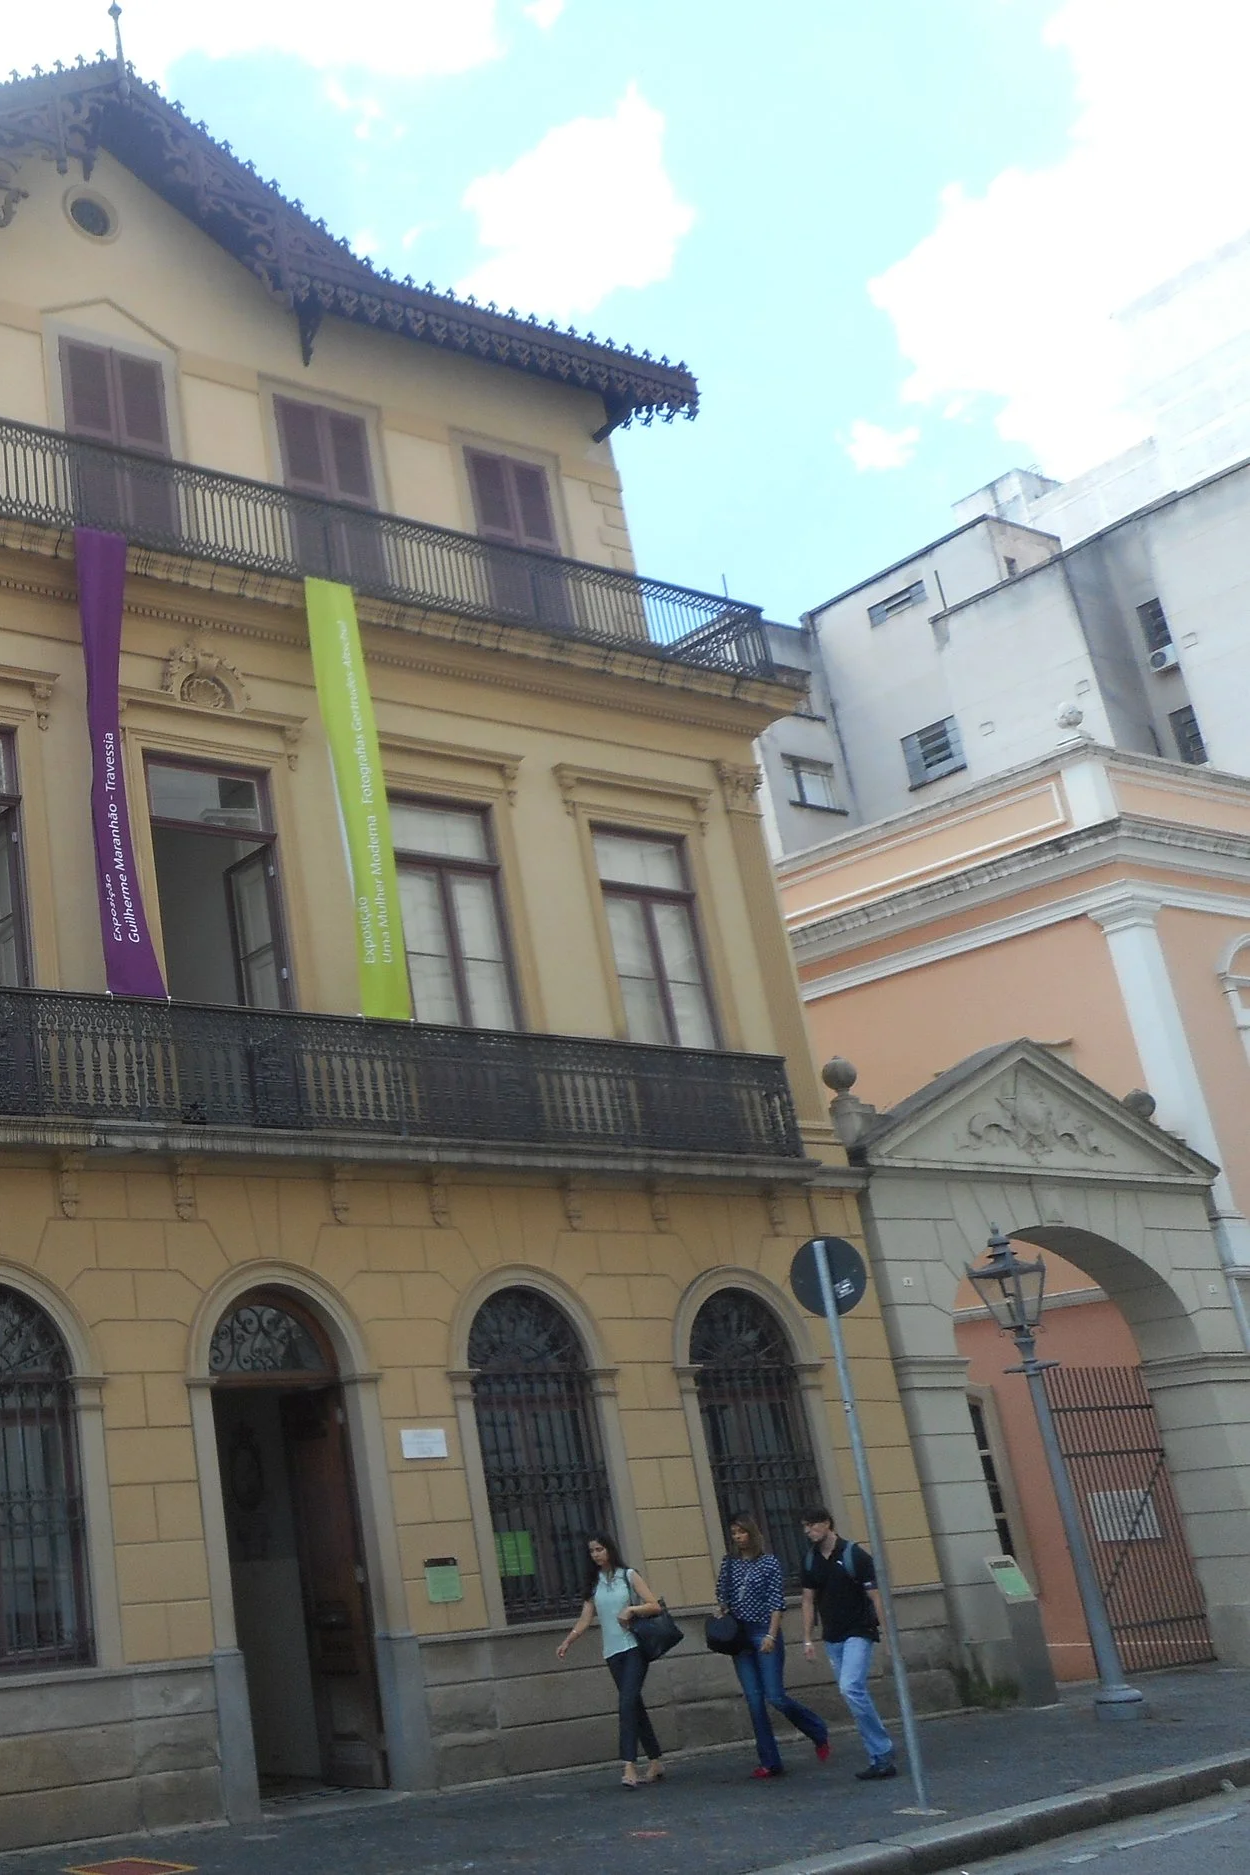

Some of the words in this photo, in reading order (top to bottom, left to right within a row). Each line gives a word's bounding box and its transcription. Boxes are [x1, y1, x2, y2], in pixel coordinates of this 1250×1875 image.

[103, 732, 116, 792] Travessia
[353, 732, 373, 804] Fotografias
[107, 803, 125, 870] Maranhão
[367, 815, 383, 876] Moderna
[105, 873, 122, 942] Exposição
[119, 873, 140, 943] Guilherme
[358, 896, 376, 964] Exposição
[375, 878, 388, 928] Mulher
[381, 931, 392, 963] Uma
